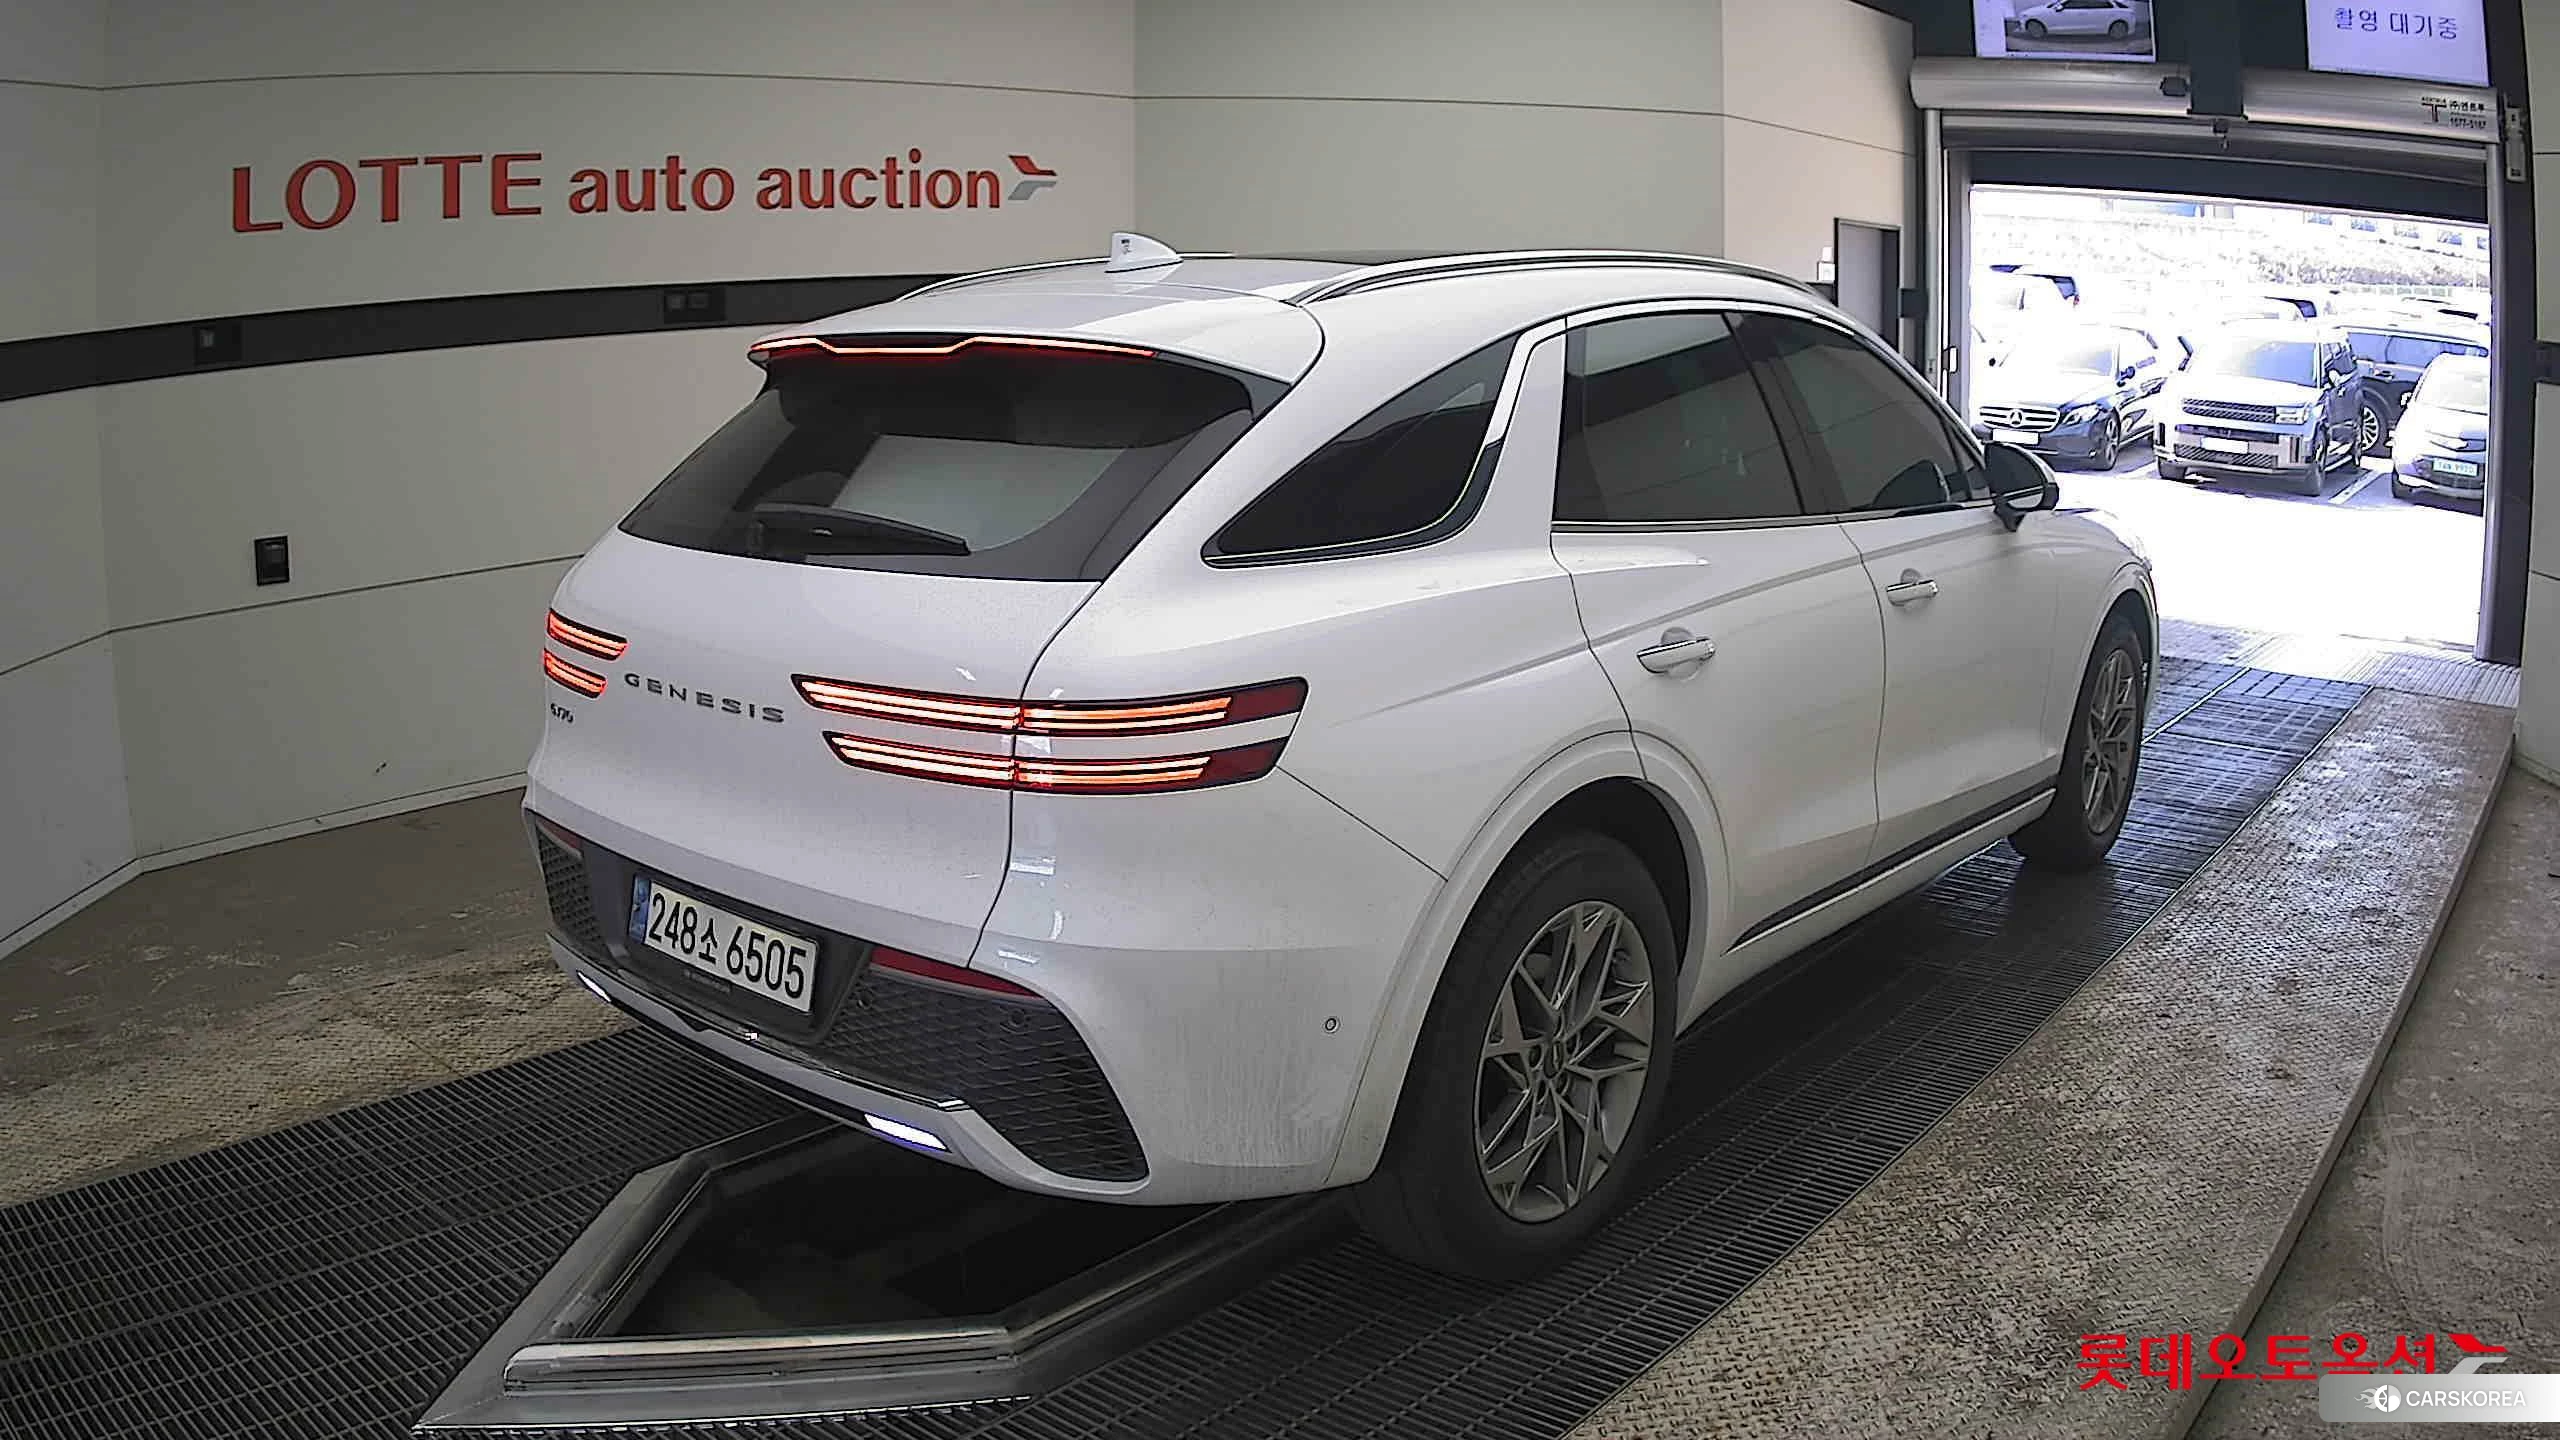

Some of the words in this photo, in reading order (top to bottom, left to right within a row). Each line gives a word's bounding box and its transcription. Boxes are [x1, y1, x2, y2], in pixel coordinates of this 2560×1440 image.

[232, 153, 543, 233] LOTTE
[568, 154, 735, 214] auto
[757, 148, 1001, 211] auction
[623, 672, 785, 723] GENESIS
[648, 892, 718, 965] 248소
[726, 925, 807, 999] 6505
